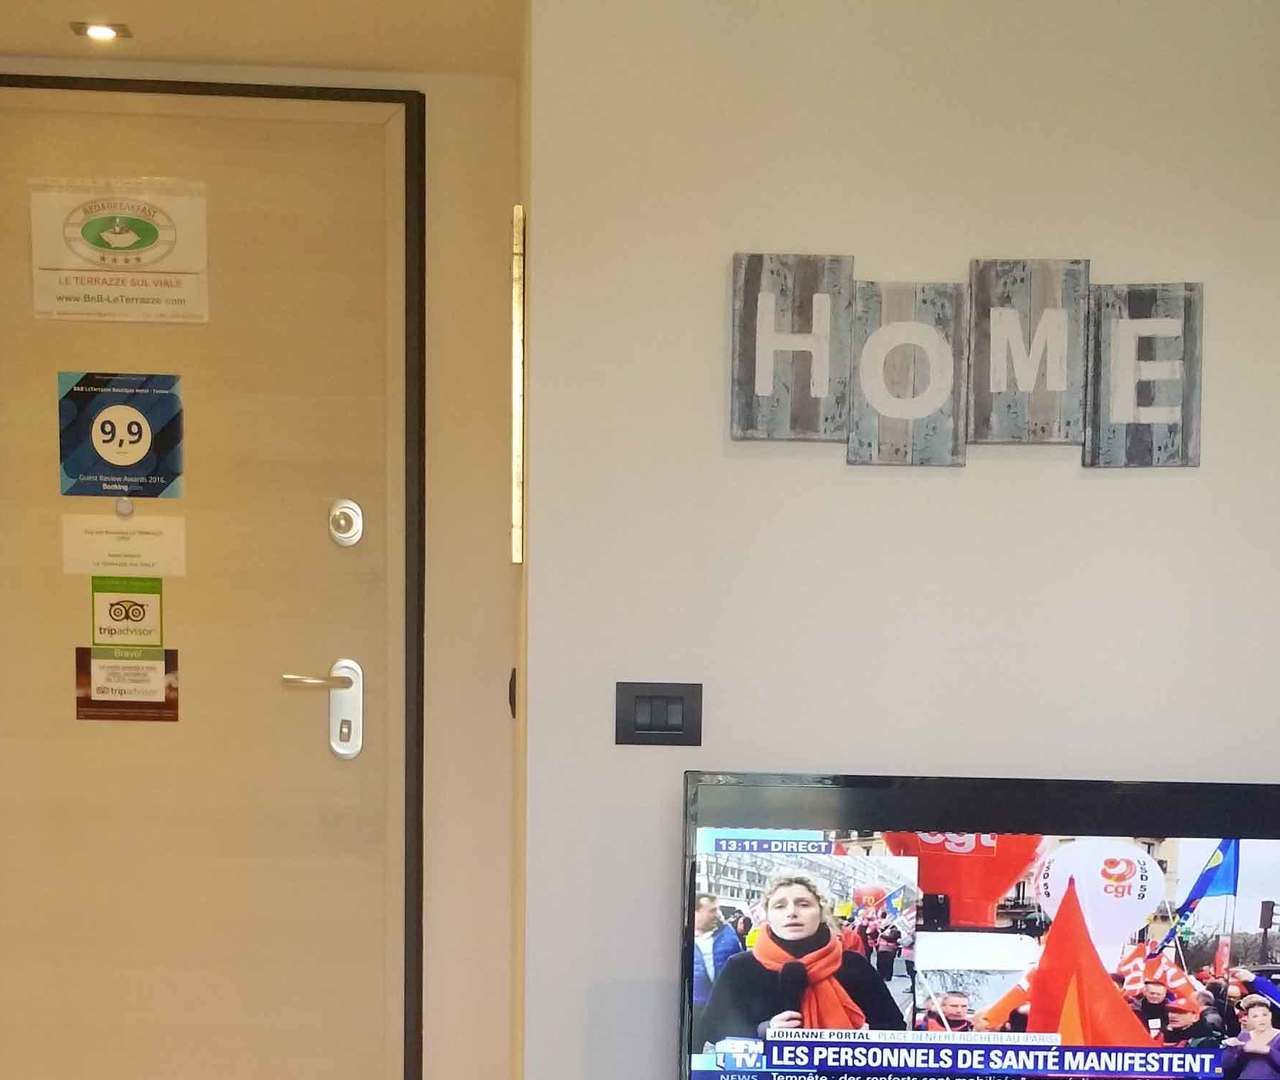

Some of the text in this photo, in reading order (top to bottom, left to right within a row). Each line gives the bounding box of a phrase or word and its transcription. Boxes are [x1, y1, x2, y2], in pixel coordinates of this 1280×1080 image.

[72, 276, 127, 288] TERRAZZE
[754, 292, 1185, 424] HOME
[100, 419, 143, 448] 9,9
[720, 840, 829, 853] 13:11 DIRECT
[771, 1030, 825, 1040] JOHANNE
[828, 1031, 871, 1040] PORTAL
[772, 1046, 1222, 1073] LES PERSONNELS DE SANTÉ MANIFESTENT.
